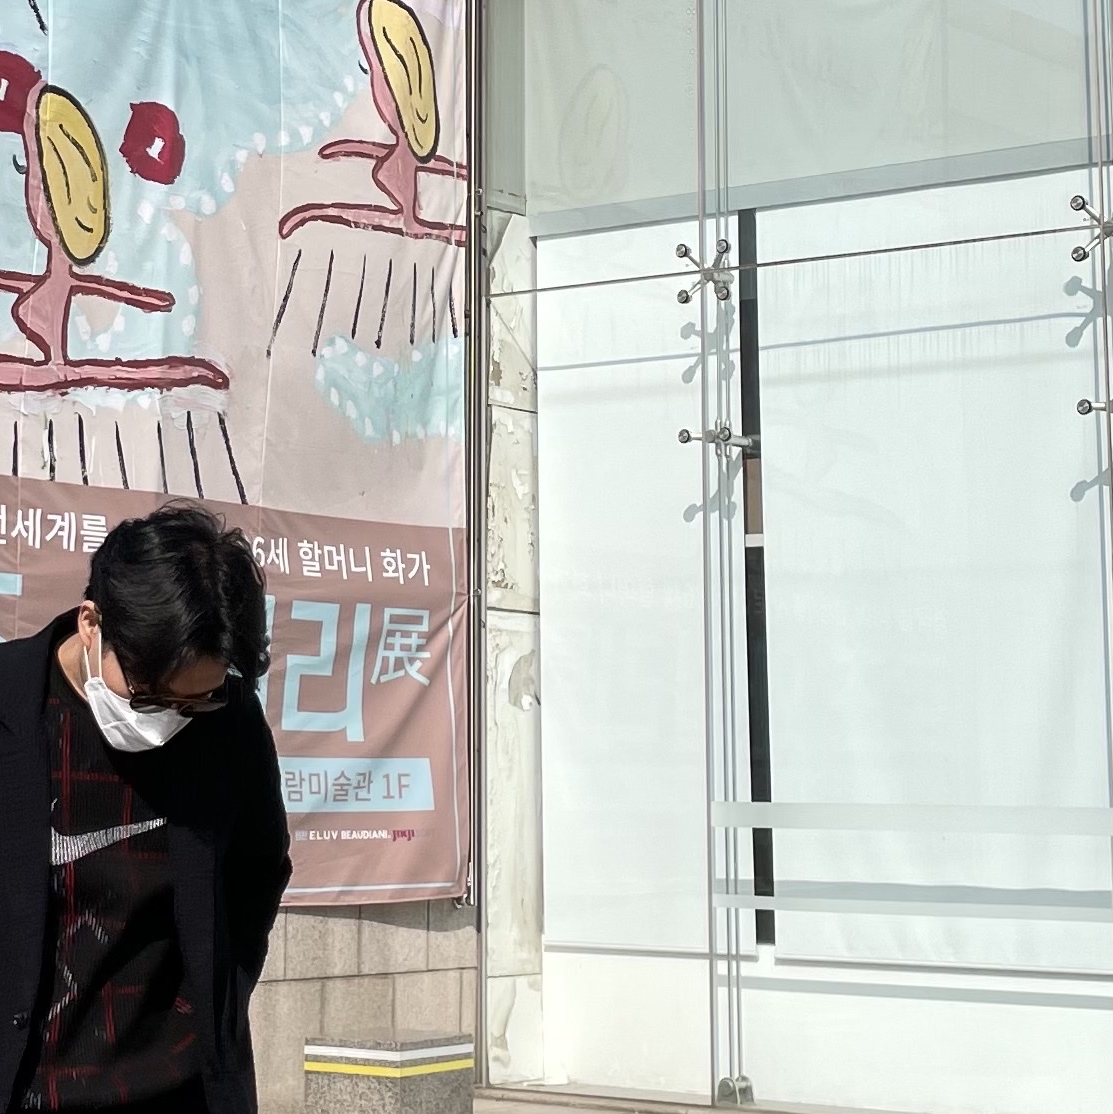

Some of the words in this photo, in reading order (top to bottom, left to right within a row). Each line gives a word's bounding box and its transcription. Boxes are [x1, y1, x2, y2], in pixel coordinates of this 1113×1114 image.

[297, 540, 373, 582] 할머니
[380, 548, 431, 586] 화가
[285, 769, 374, 803] 람미술관
[382, 773, 412, 800] 1F
